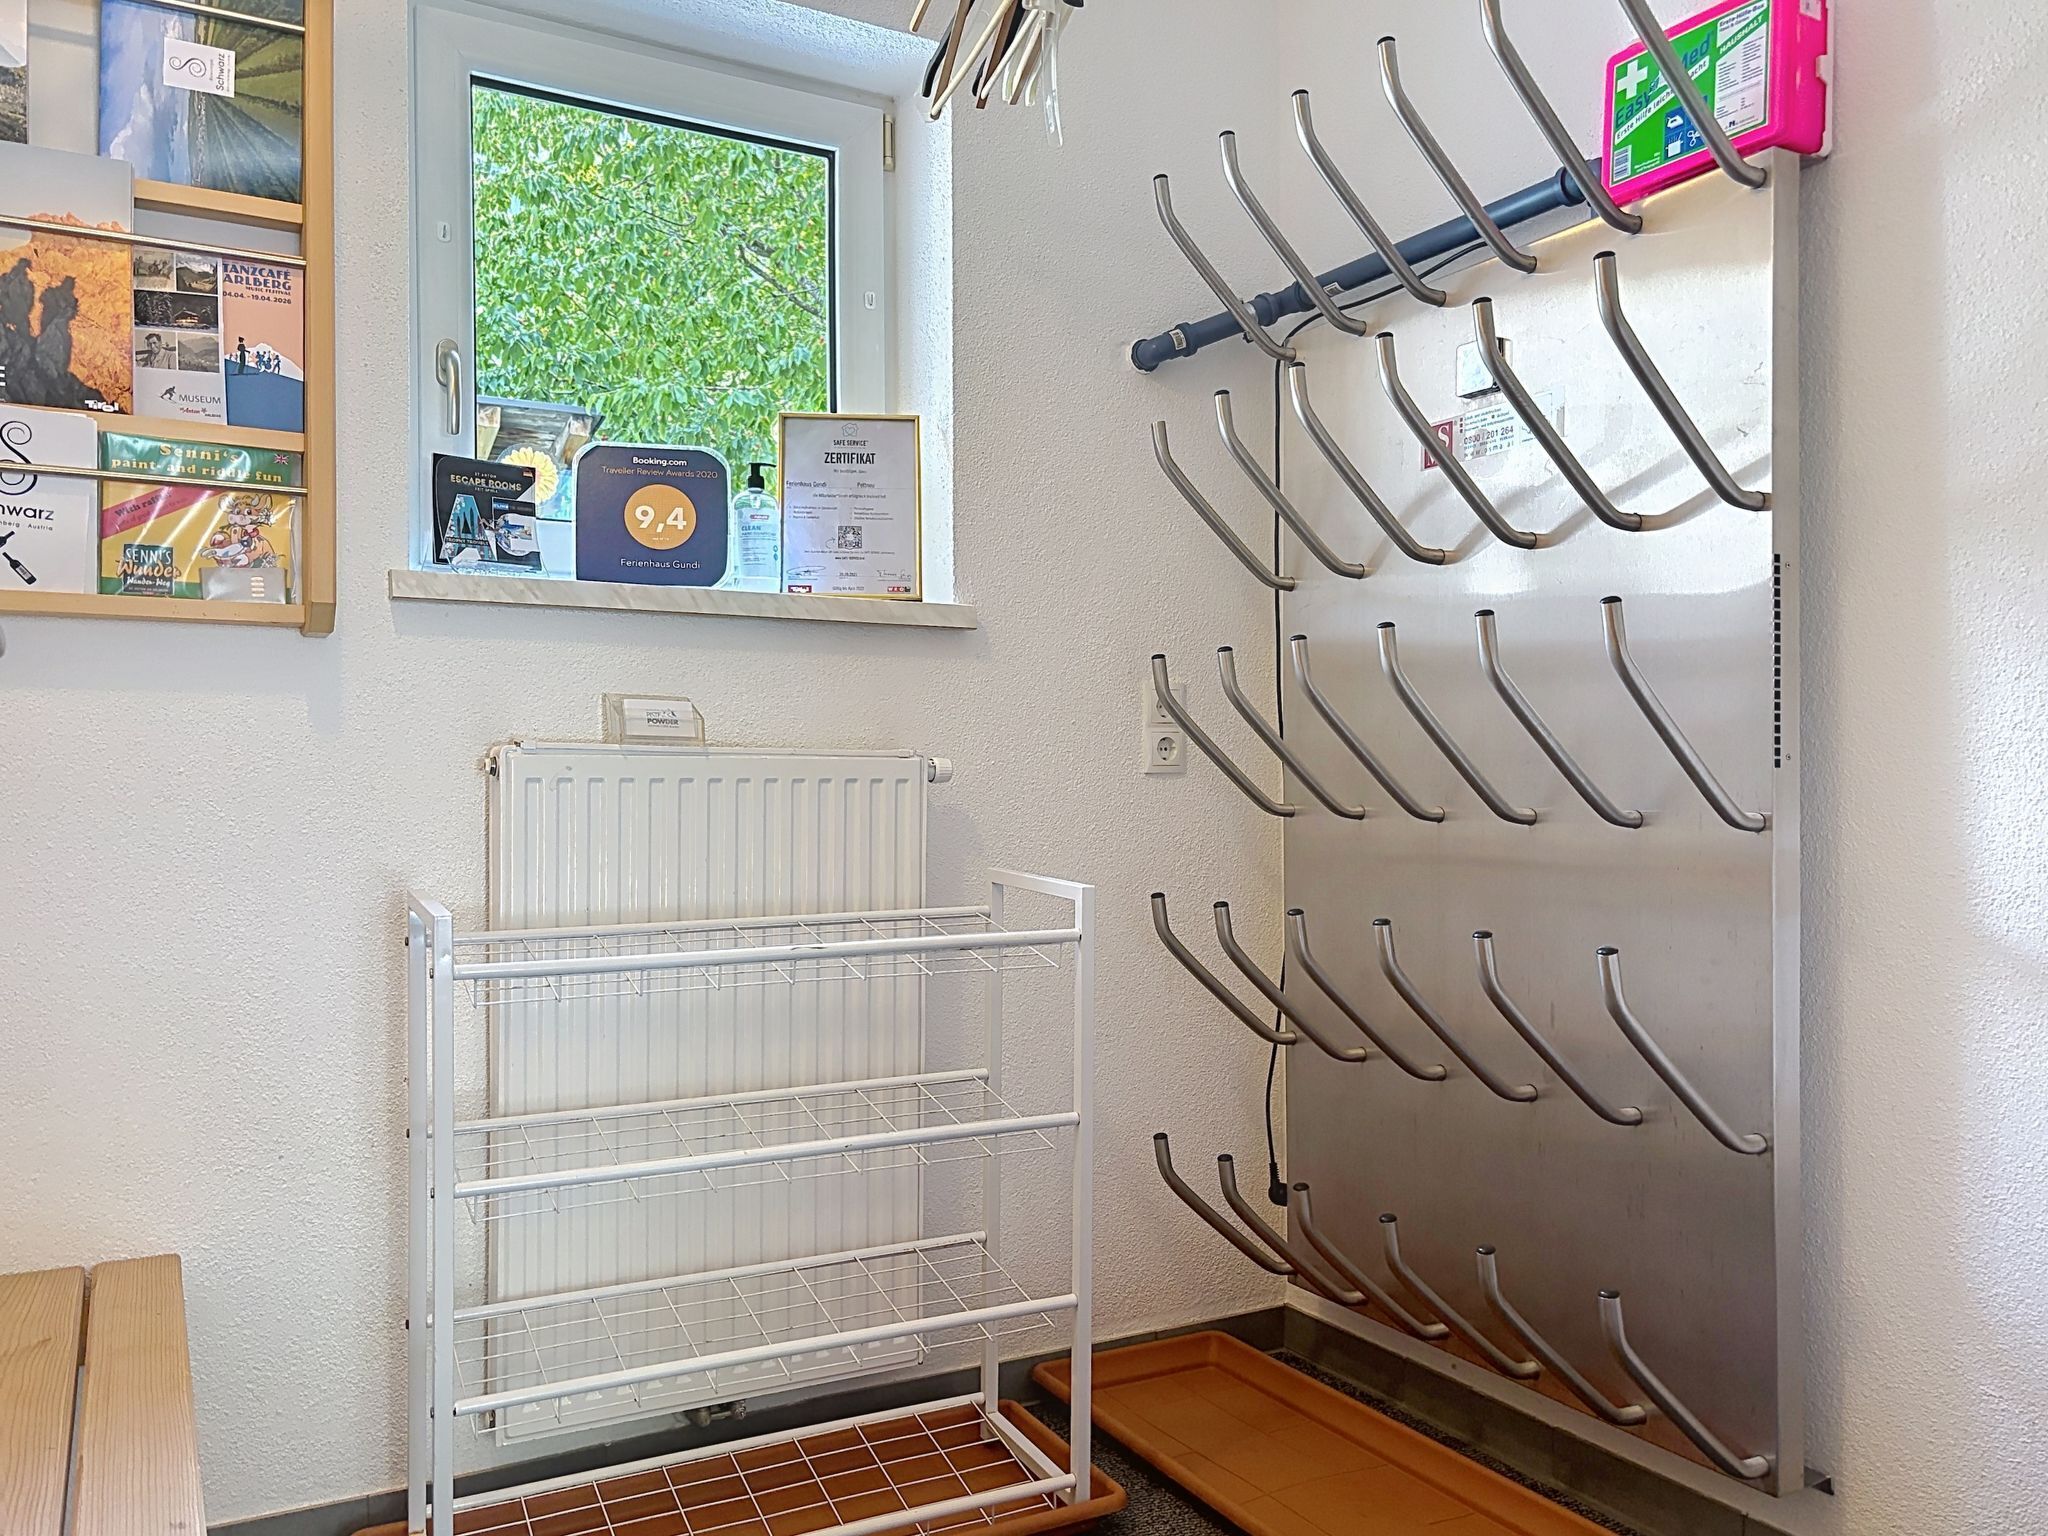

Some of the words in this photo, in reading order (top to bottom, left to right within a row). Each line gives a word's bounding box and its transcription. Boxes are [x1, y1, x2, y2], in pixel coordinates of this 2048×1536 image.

[1719, 14, 1764, 55] HAUSHALT
[215, 52, 226, 91] Schwarz
[1615, 91, 1651, 128] Easy
[1616, 122, 1634, 140] Erste
[1635, 105, 1652, 123] Hilfe
[222, 263, 292, 281] TANZCAFÉ
[222, 273, 292, 291] ARLBERG
[84, 399, 119, 413] Tirol
[178, 394, 222, 405] MUSEUM
[632, 456, 688, 467] Booking.com
[824, 452, 876, 465] ZERTIFIKAT
[111, 458, 162, 470] paint-
[255, 471, 283, 483] fun
[601, 466, 635, 475] Traveller
[636, 468, 664, 476] Review
[665, 469, 695, 478] Awards
[696, 470, 718, 479] 2020
[450, 474, 487, 487] ESCAPE
[488, 480, 522, 492] ROOMS
[115, 503, 141, 517] With
[634, 505, 687, 533] 9,4
[28, 523, 53, 531] Austria
[125, 548, 172, 565] SENNI'S
[620, 558, 671, 569] Ferienhaus
[672, 560, 701, 570] Gundi
[115, 559, 182, 578] Wunder
